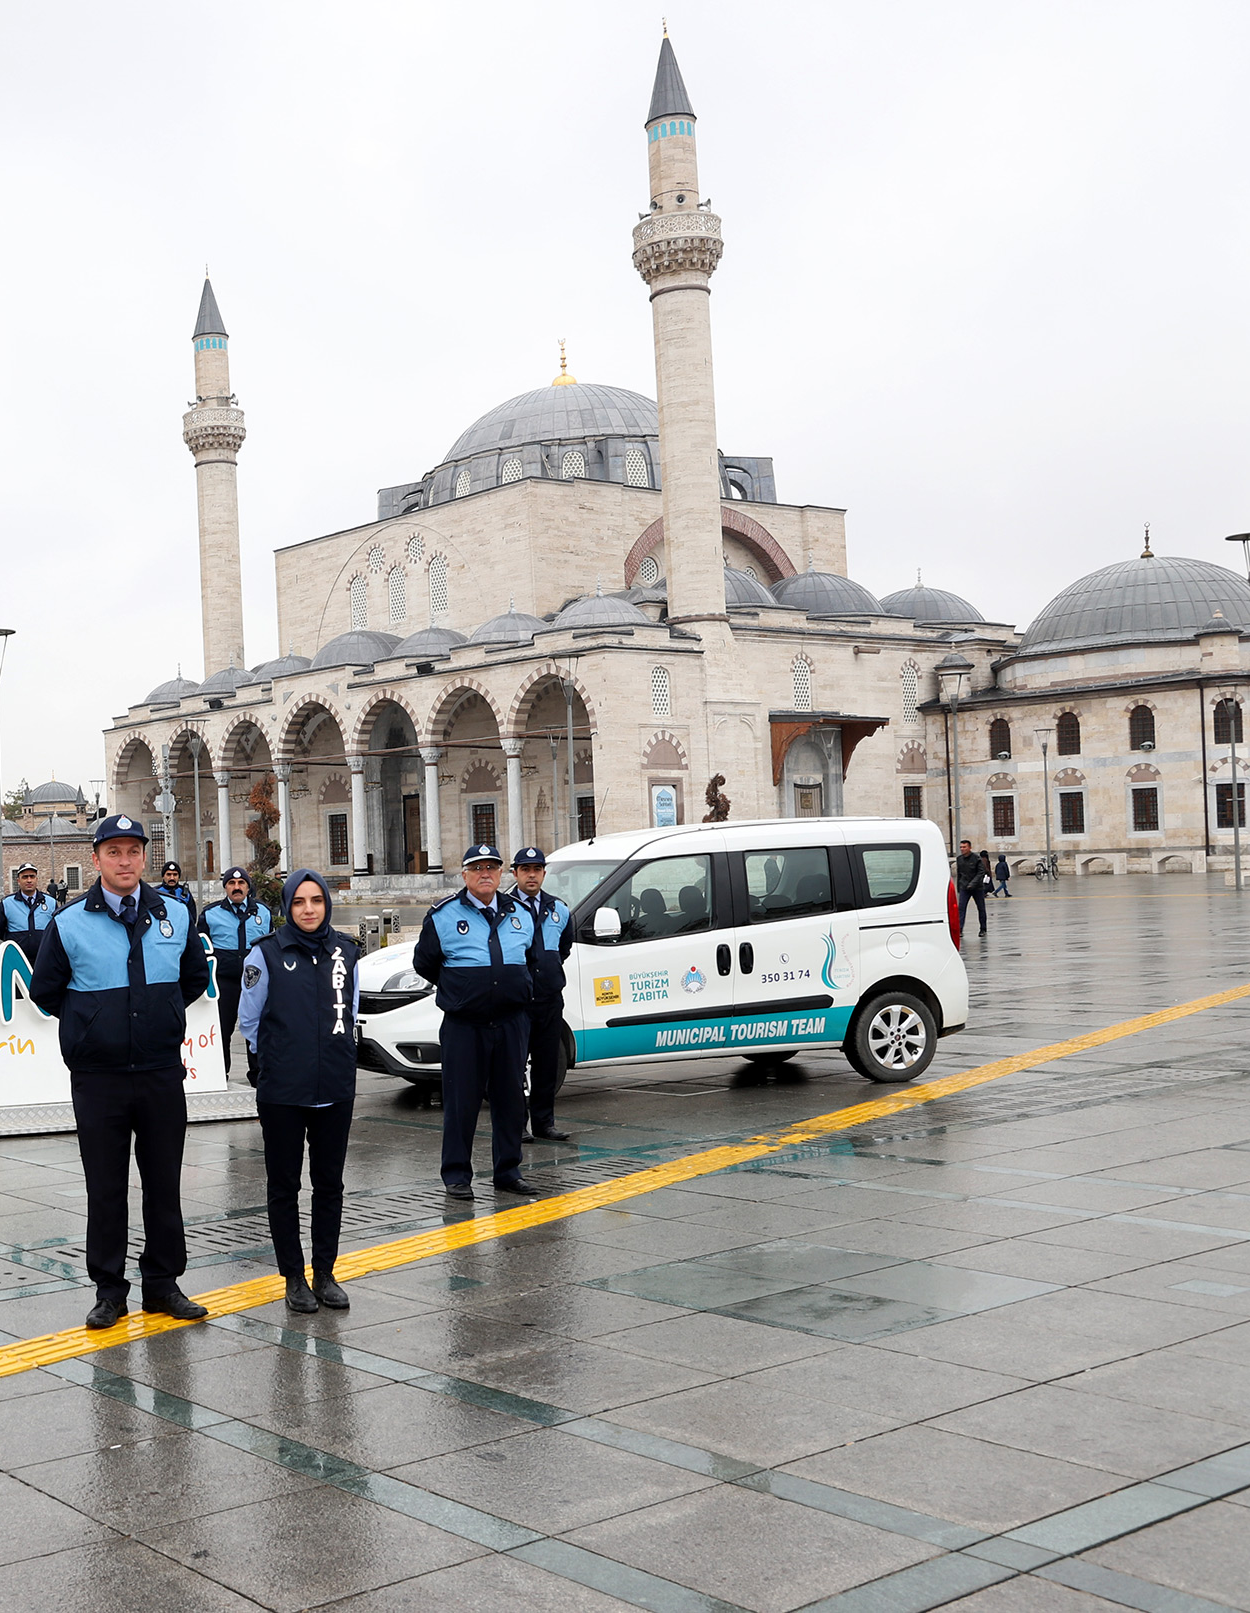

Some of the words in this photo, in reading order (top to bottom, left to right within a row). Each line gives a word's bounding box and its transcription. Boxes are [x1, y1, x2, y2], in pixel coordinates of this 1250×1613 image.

[629, 970, 668, 980] BÜYÜKŞEHİR
[761, 973, 780, 983] 350
[783, 971, 795, 981] 31
[798, 969, 810, 979] 74
[331, 946, 347, 1035] ZABITA
[630, 978, 669, 990] TURİZM
[632, 990, 669, 1003] ZABITA
[198, 1024, 216, 1048] of
[655, 1026, 726, 1047] MUNICIPAL
[730, 1020, 788, 1041] TOURISM
[791, 1017, 826, 1035] TEAM
